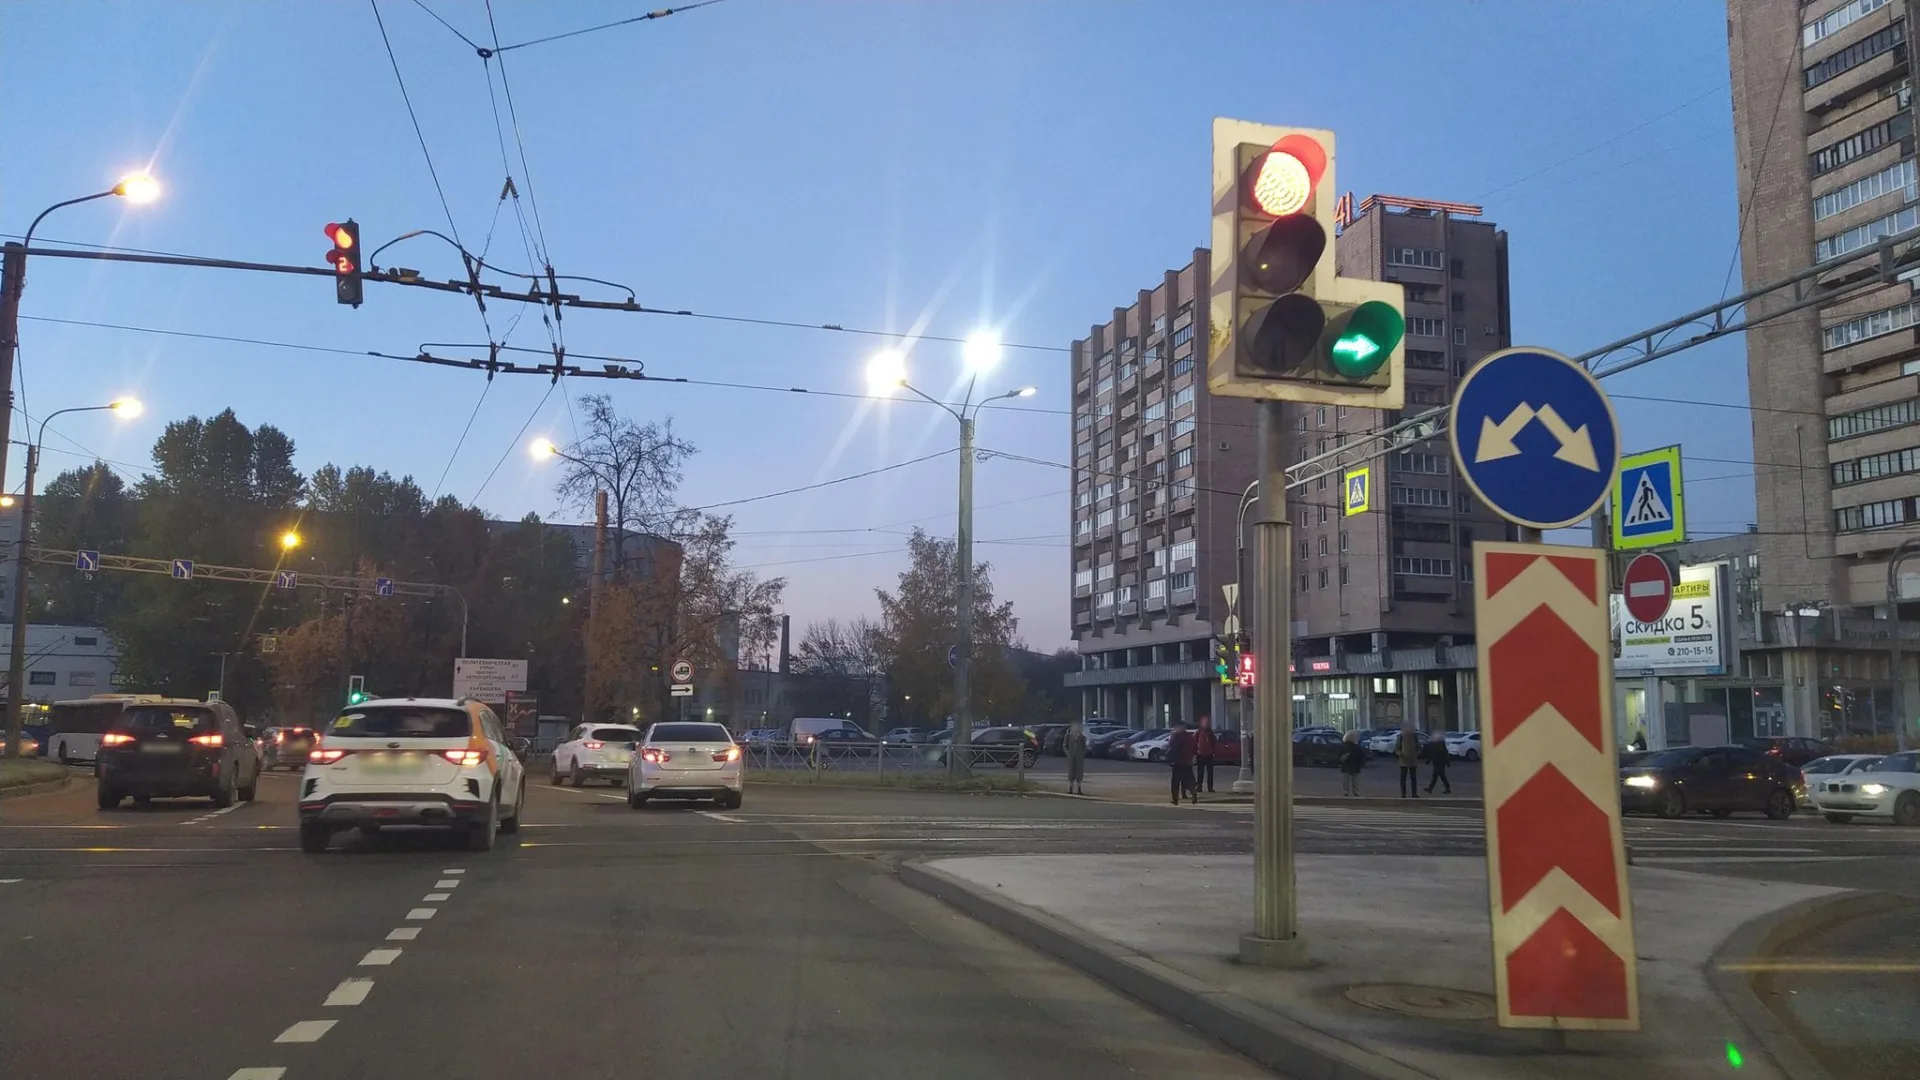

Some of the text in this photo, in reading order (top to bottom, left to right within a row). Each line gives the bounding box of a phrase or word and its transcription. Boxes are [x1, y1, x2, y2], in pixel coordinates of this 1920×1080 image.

[1625, 616, 1685, 635] скидка
[1677, 646, 1713, 656] 210-15-15
[1241, 671, 1255, 685] 27
